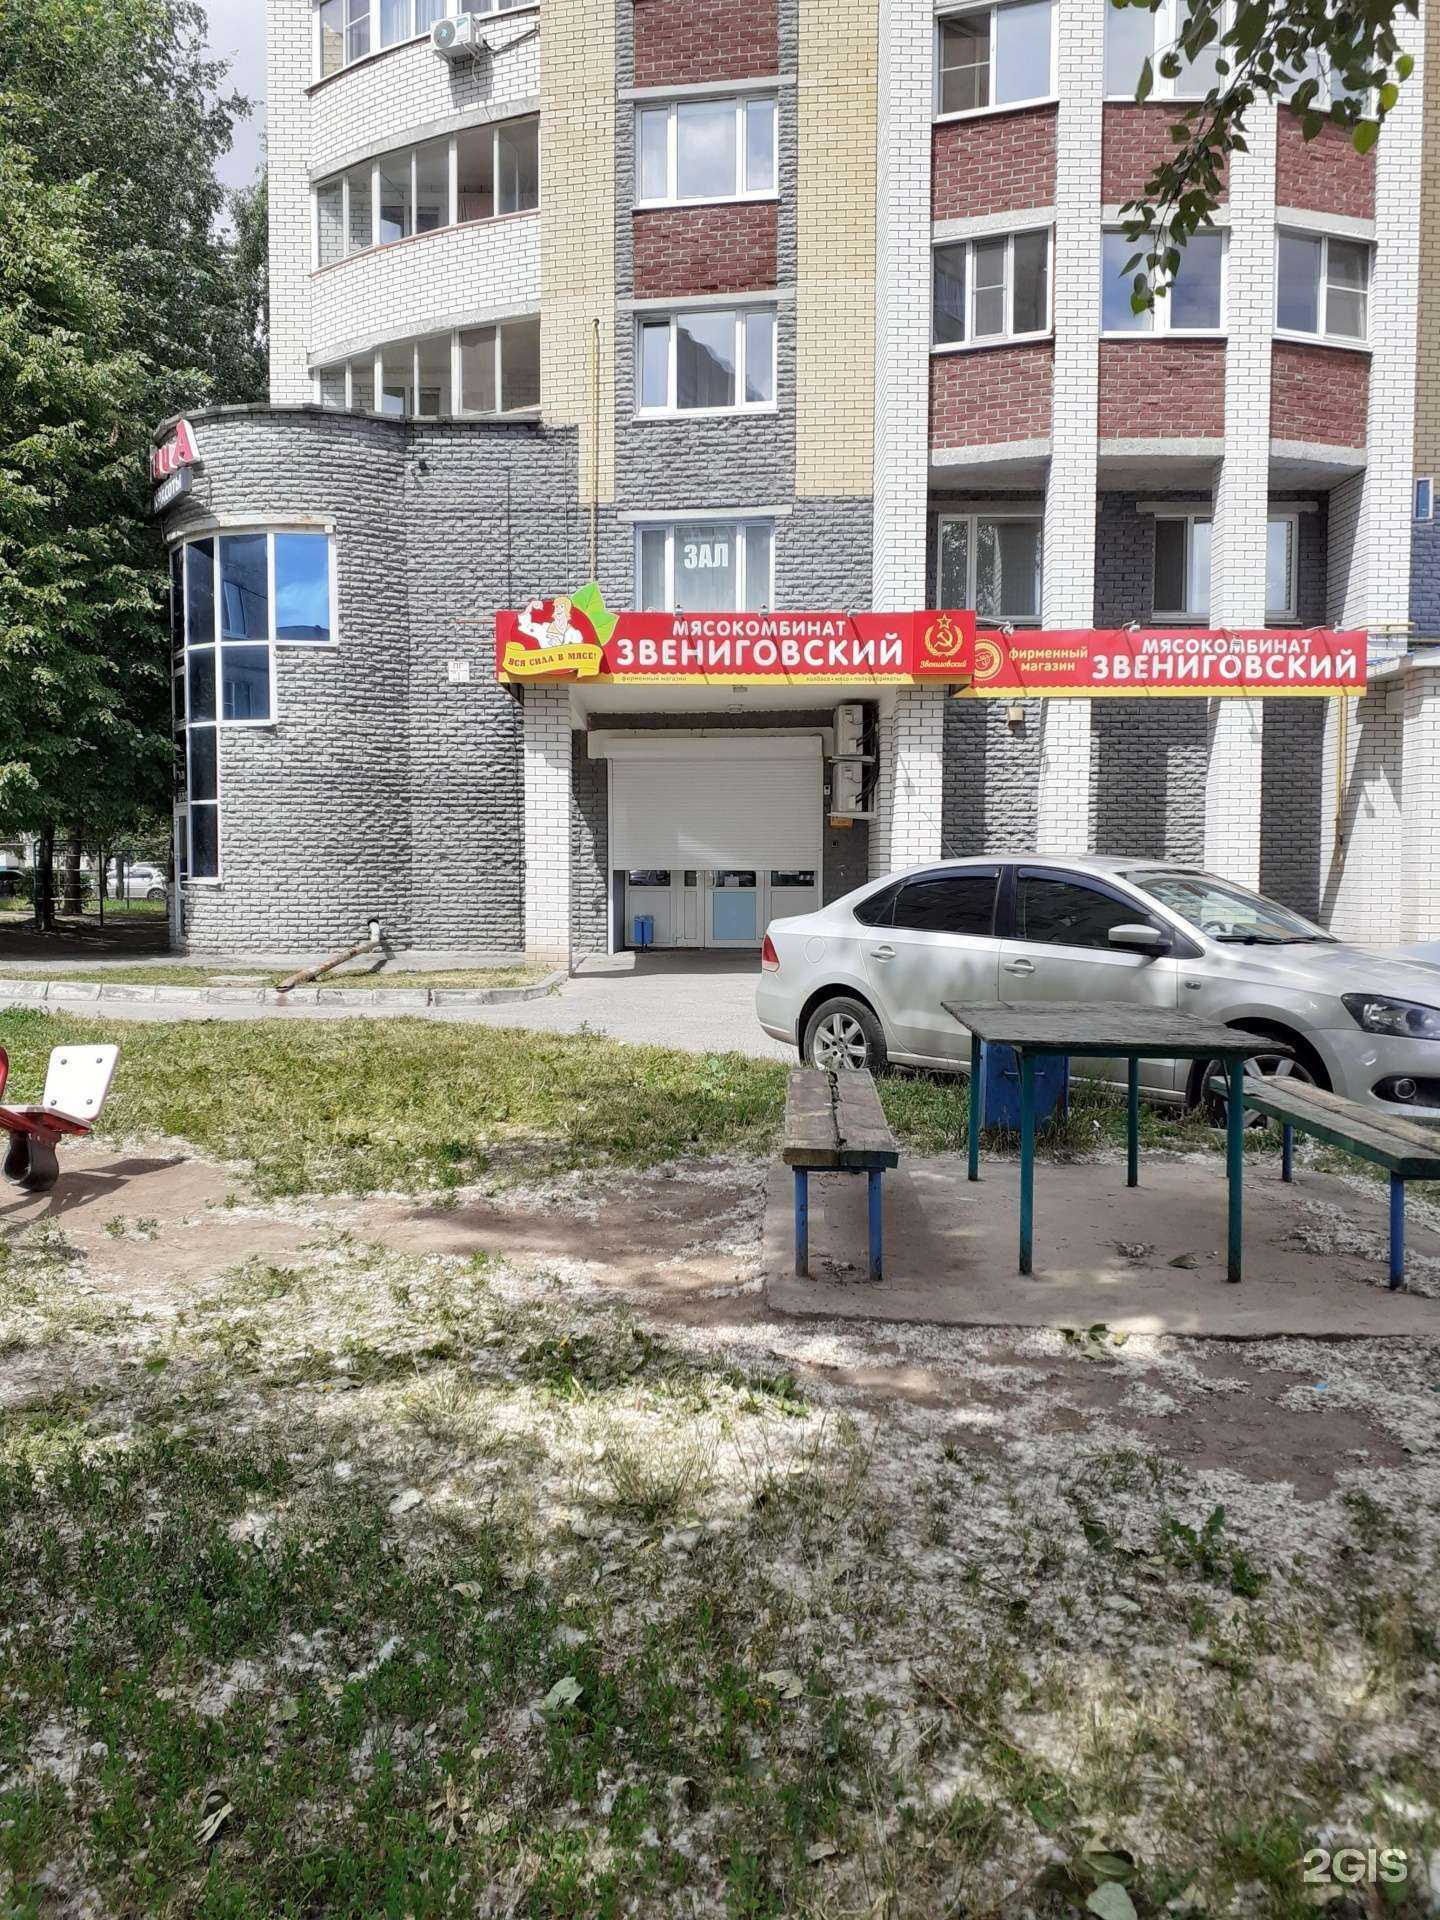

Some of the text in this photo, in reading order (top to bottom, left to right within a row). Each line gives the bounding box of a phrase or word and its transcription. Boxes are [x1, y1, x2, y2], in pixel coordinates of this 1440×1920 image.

[684, 543, 729, 569] ЗАЛ
[673, 619, 846, 637] МЯСОКОМБИНАТ
[616, 632, 903, 667] ЗВЕНИГОВСКИЙ
[1009, 646, 1088, 661] фирменный
[1142, 637, 1312, 655] МЯСОКОМБИНАТ
[529, 656, 554, 666] СИЛА
[558, 653, 564, 662] В
[1021, 662, 1076, 671] магазин
[1092, 648, 1357, 680] ЗВЕНИГОВСКИЙ
